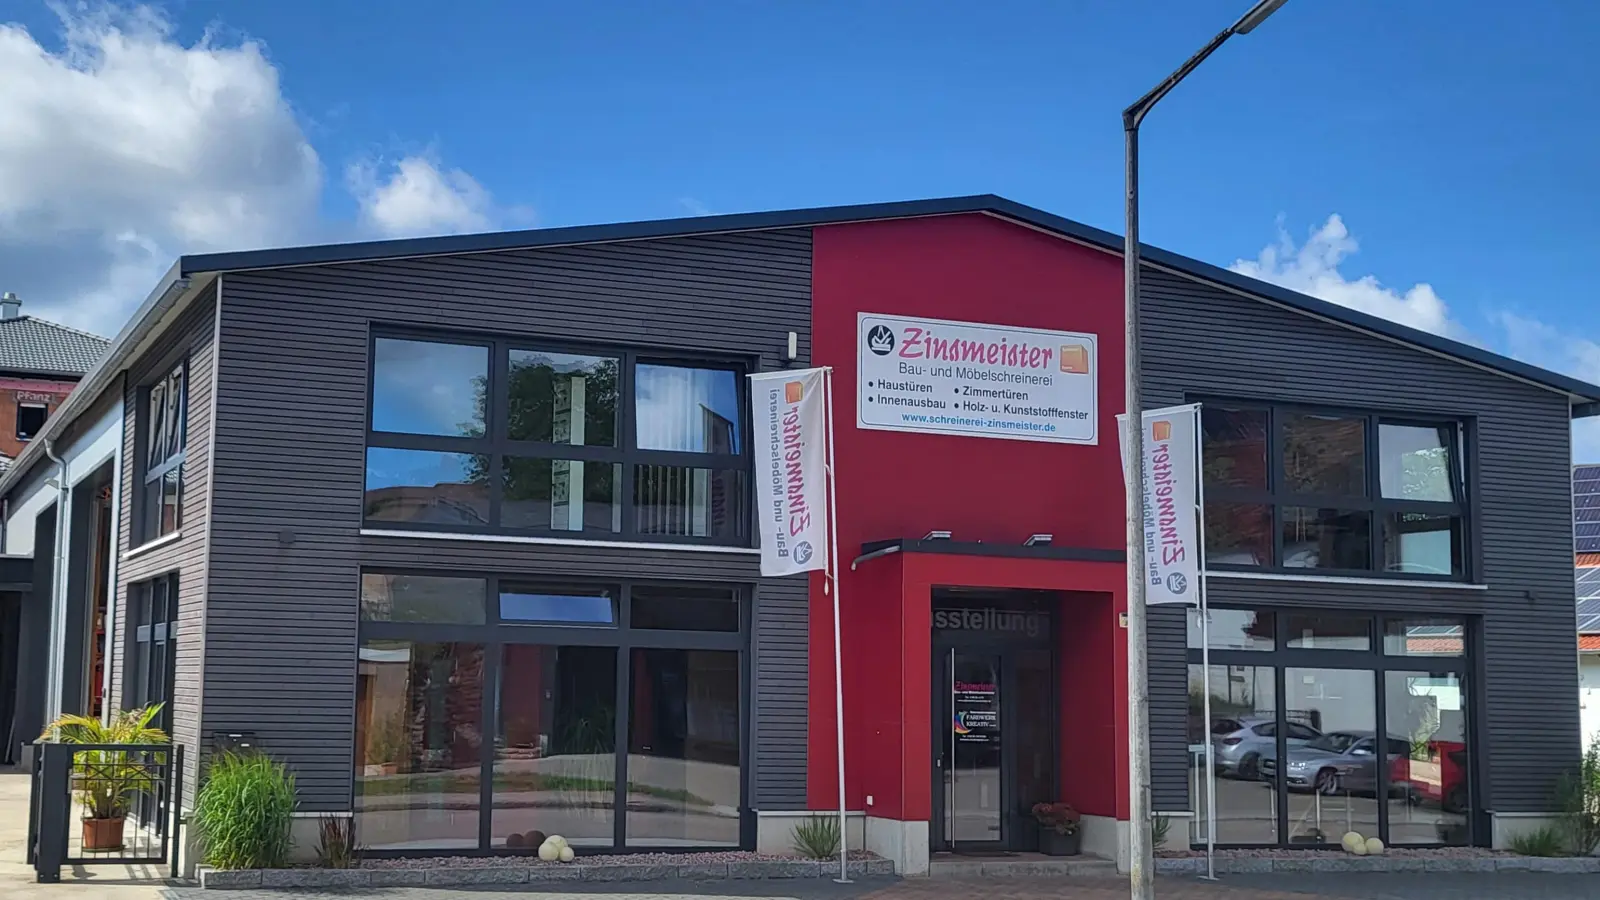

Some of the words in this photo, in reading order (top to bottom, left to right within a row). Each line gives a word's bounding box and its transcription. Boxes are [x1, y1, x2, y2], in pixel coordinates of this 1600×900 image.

[899, 328, 1053, 369] Zinsmeister
[899, 362, 927, 375] Bau-
[930, 366, 951, 377] und
[956, 367, 1053, 386] Möbelschreinerei
[877, 379, 933, 393] Haustüren
[962, 386, 1029, 400] Zimmertüren
[877, 394, 946, 409] Innenausbau
[963, 401, 989, 412] Holz-
[991, 404, 1001, 413] u.
[1003, 403, 1089, 420] Kunststofffenster
[901, 413, 1056, 432] www.schreinerei-zinsmeister.de
[931, 607, 1039, 637] sstellung
